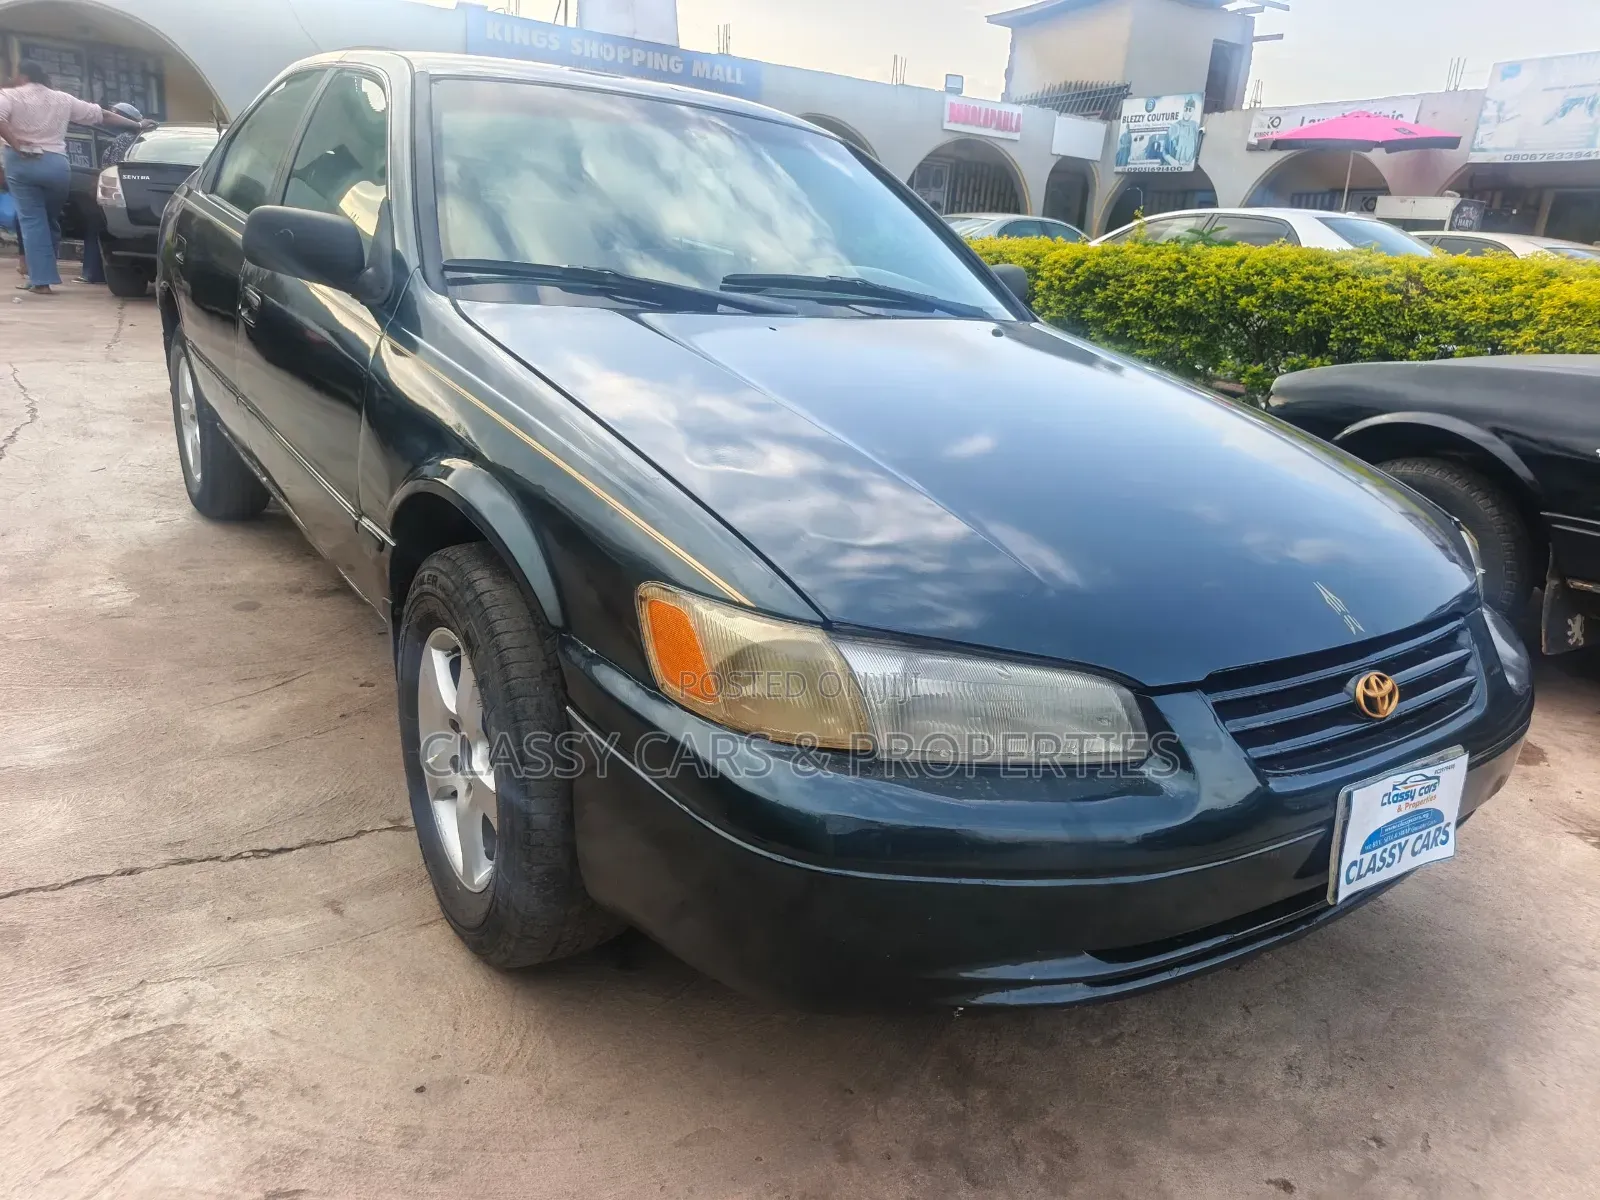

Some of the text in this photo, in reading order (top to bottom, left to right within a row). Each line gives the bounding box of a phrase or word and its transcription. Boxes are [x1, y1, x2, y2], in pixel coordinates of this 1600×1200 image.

[486, 20, 561, 51] KINGS
[570, 37, 684, 74] SHOPPING
[692, 60, 745, 85] MALL
[1121, 111, 1180, 124] BLEZZY COUTURE
[1404, 795, 1437, 811] Properties
[1345, 822, 1451, 885] CLASSY CARS
